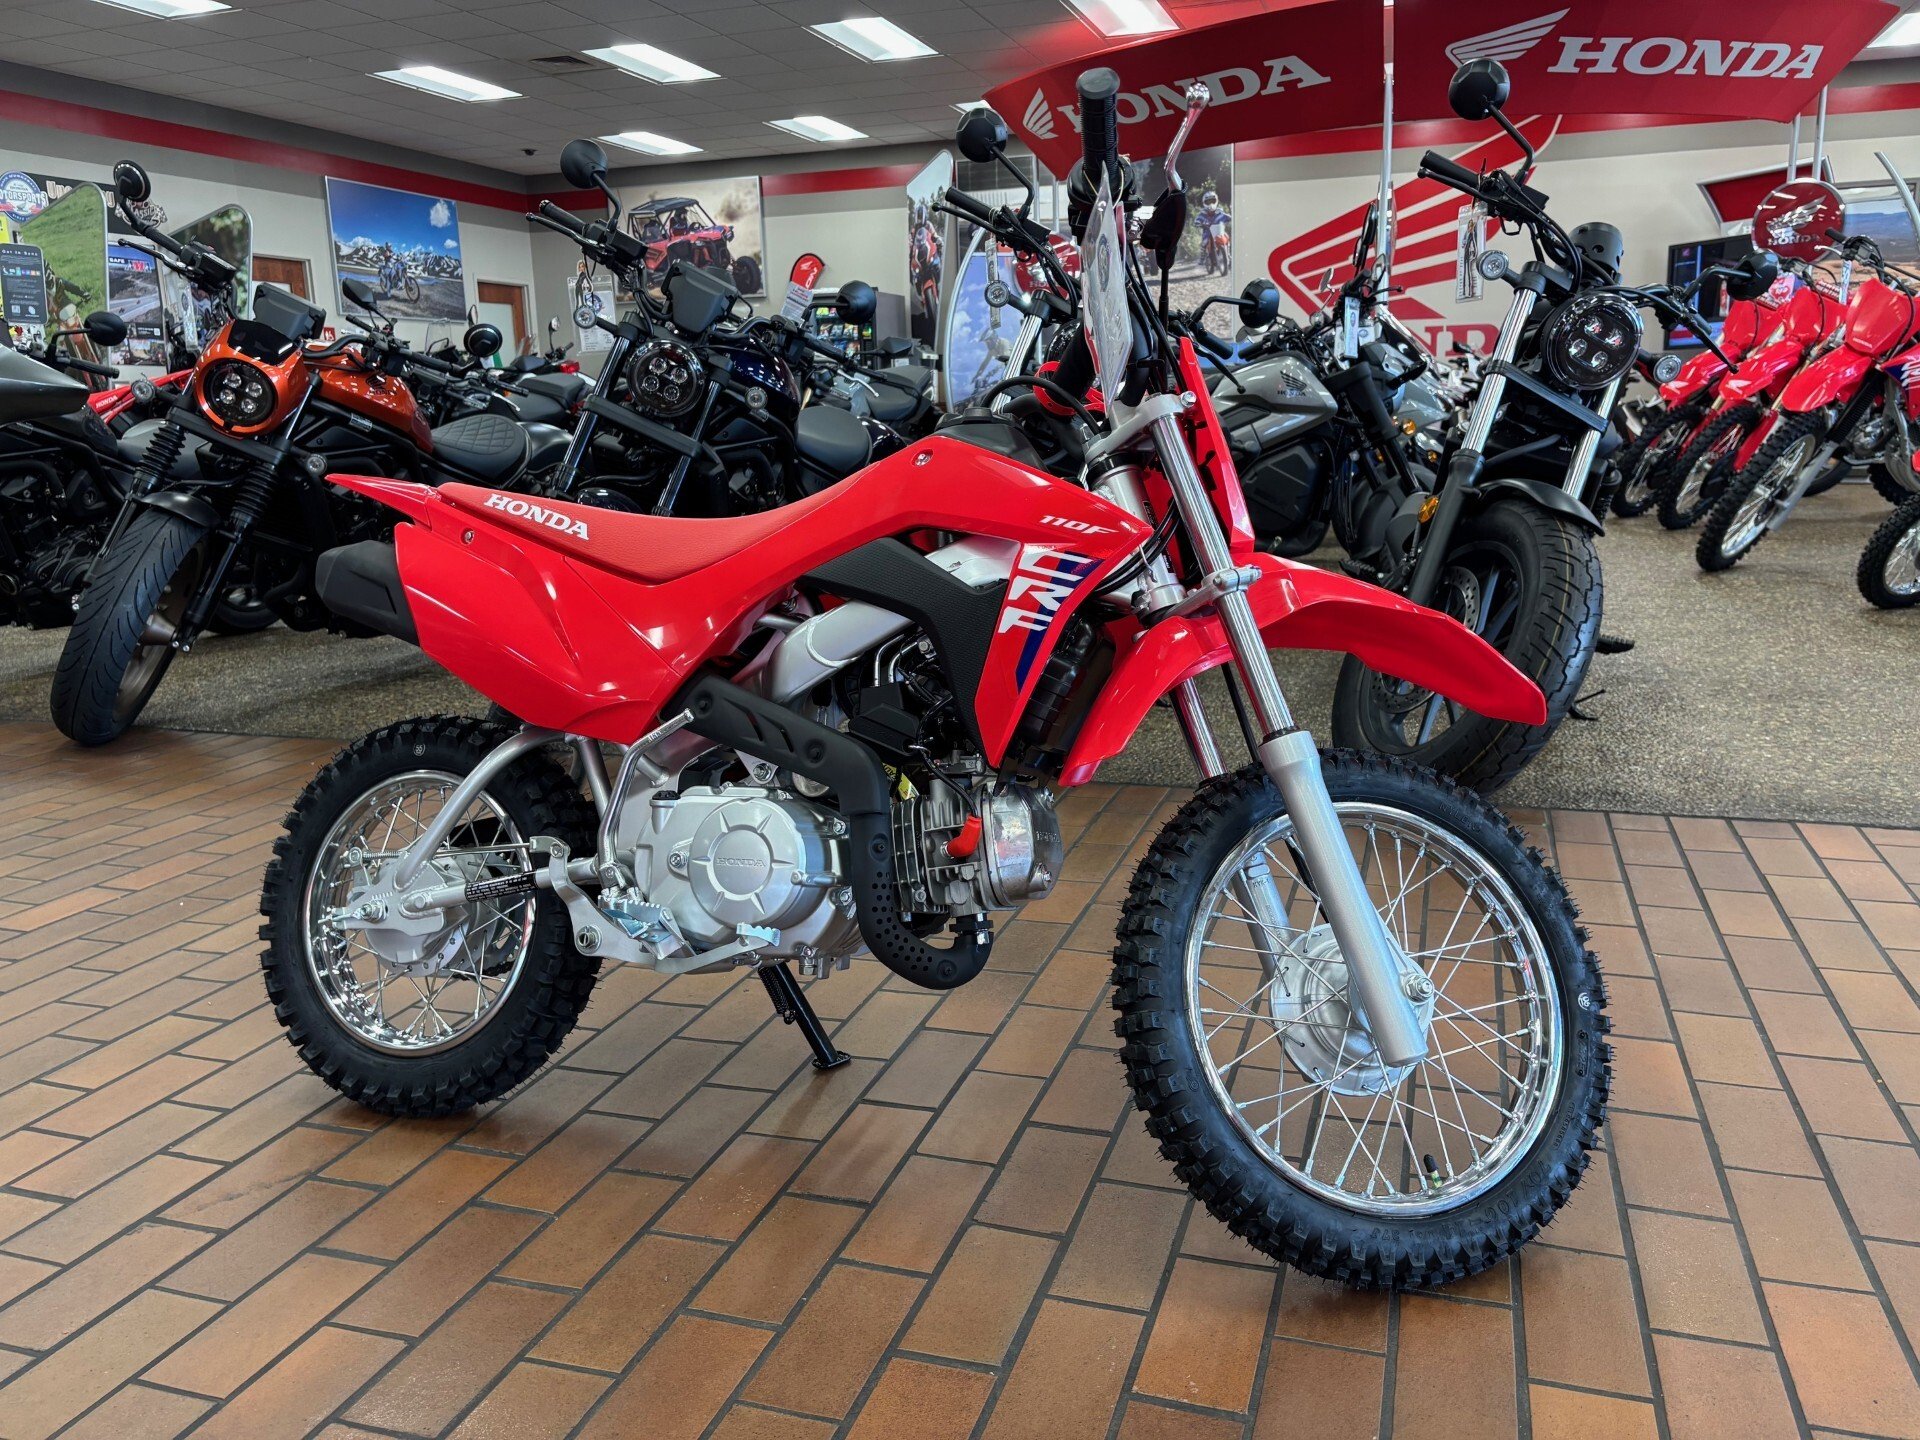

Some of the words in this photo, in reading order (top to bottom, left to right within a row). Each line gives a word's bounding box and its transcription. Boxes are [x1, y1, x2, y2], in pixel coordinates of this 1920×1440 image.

[1547, 36, 1824, 79] HONDA
[1768, 234, 1821, 246] HONDA
[95, 395, 118, 409] HONDA
[483, 493, 589, 541] HONDA
[1040, 515, 1119, 534] 110F
[998, 543, 1094, 634] CRF
[716, 857, 766, 867] HONDA
